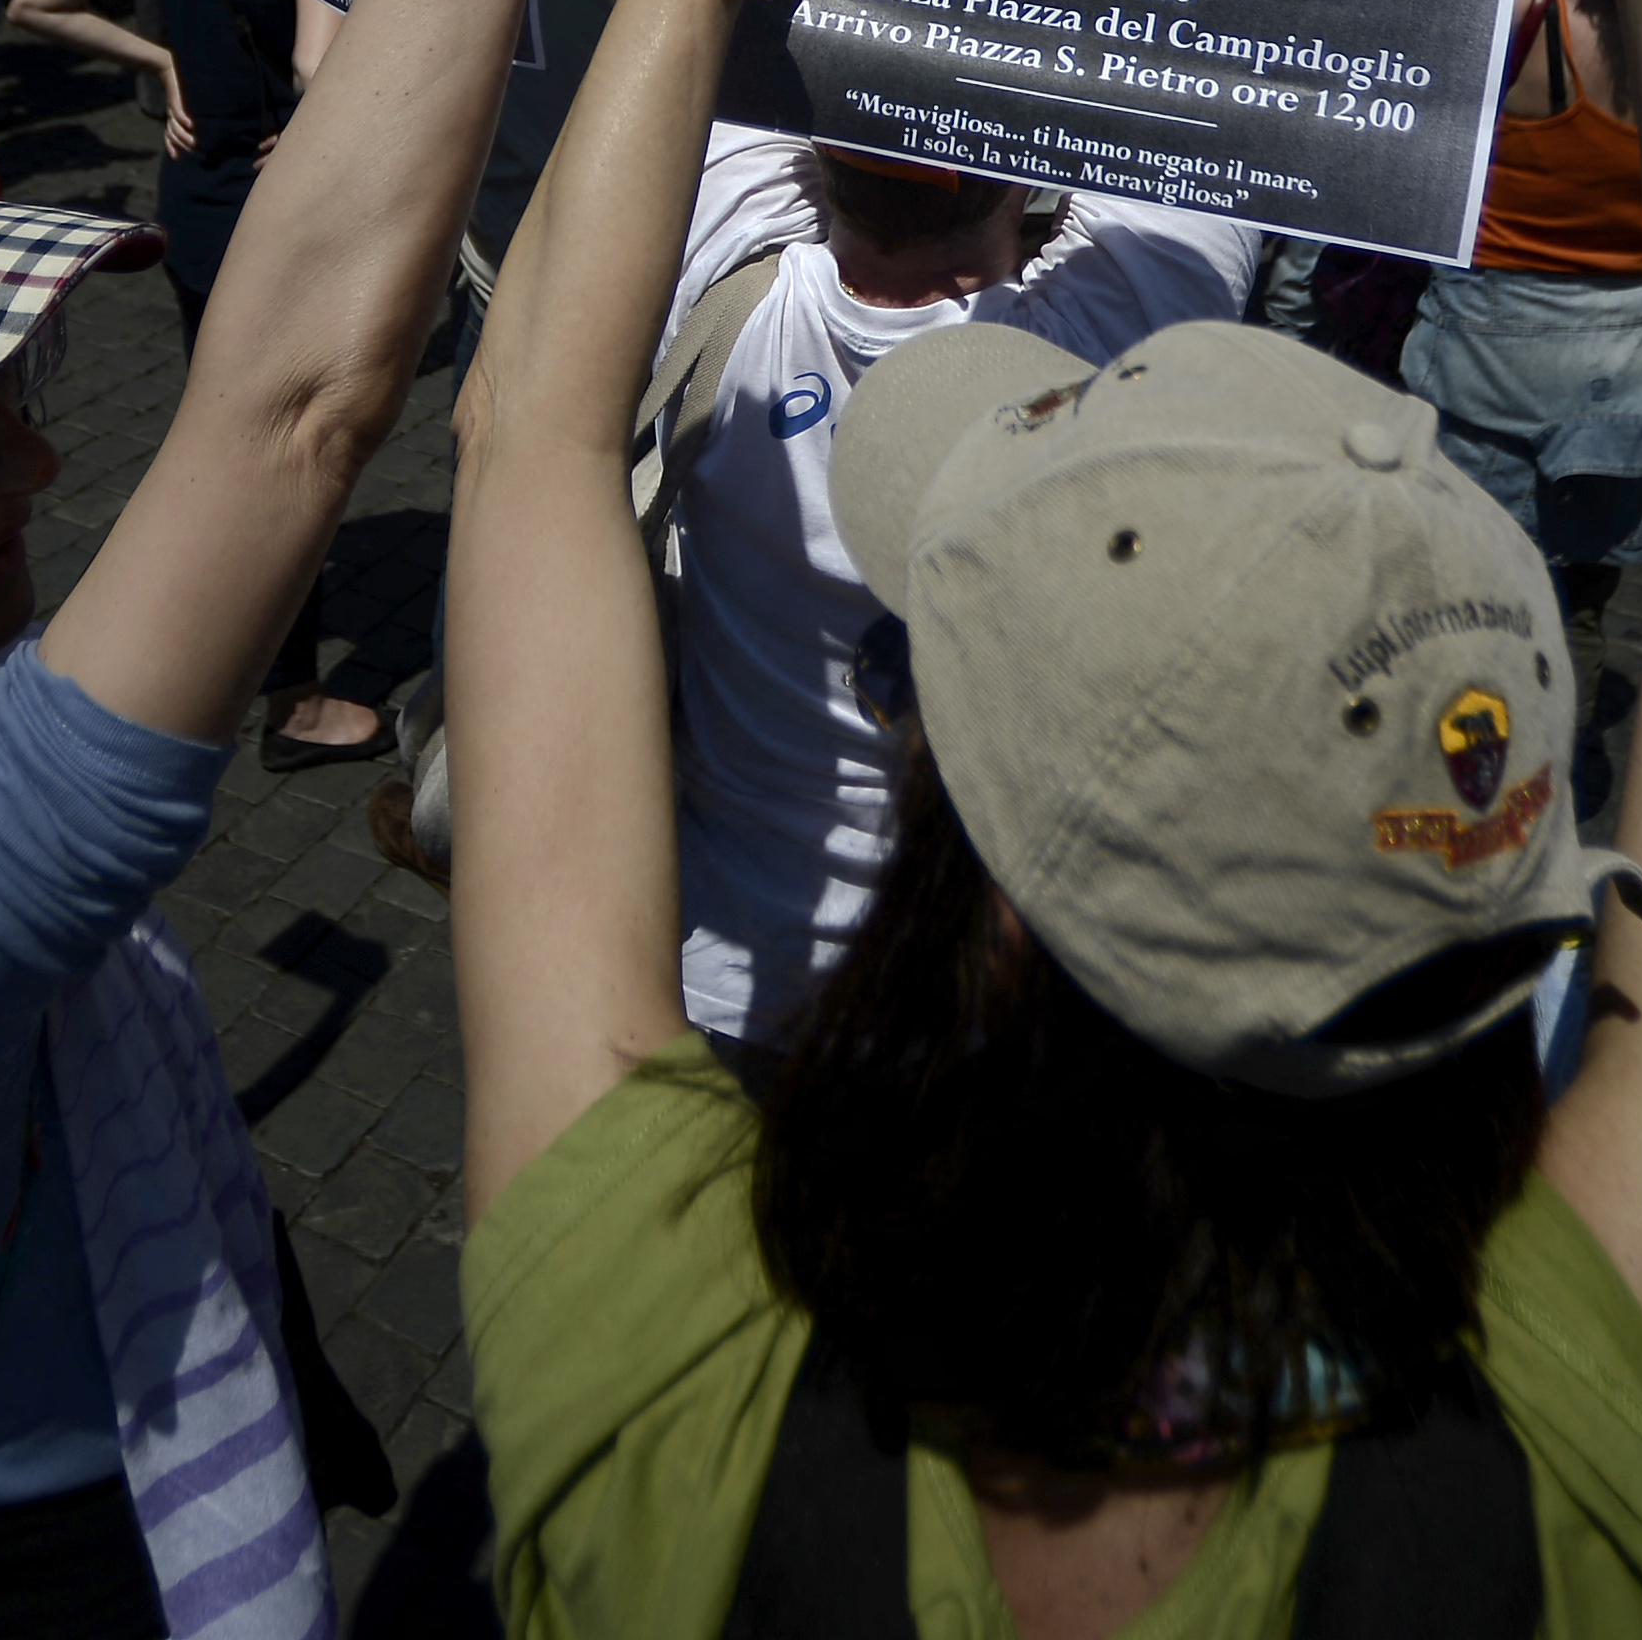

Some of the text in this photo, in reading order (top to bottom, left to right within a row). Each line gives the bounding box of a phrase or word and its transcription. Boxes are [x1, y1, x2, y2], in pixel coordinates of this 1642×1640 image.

[923, 21, 1043, 71] Piazza
[1053, 44, 1085, 78] S.
[1098, 52, 1220, 100] Pietro
[1230, 82, 1300, 116] ore
[1313, 88, 1417, 133] 12,00
[1094, 7, 1155, 44] del
[1168, 18, 1431, 91] Campidoglio
[901, 126, 919, 149] il
[921, 132, 977, 166] sole,
[980, 140, 1002, 166] la
[1006, 149, 1074, 180] vita...
[1031, 123, 1051, 148] ti
[1055, 126, 1134, 163] hanno
[1137, 148, 1222, 185] negato
[1225, 160, 1245, 184] il
[1248, 168, 1321, 200] mare,
